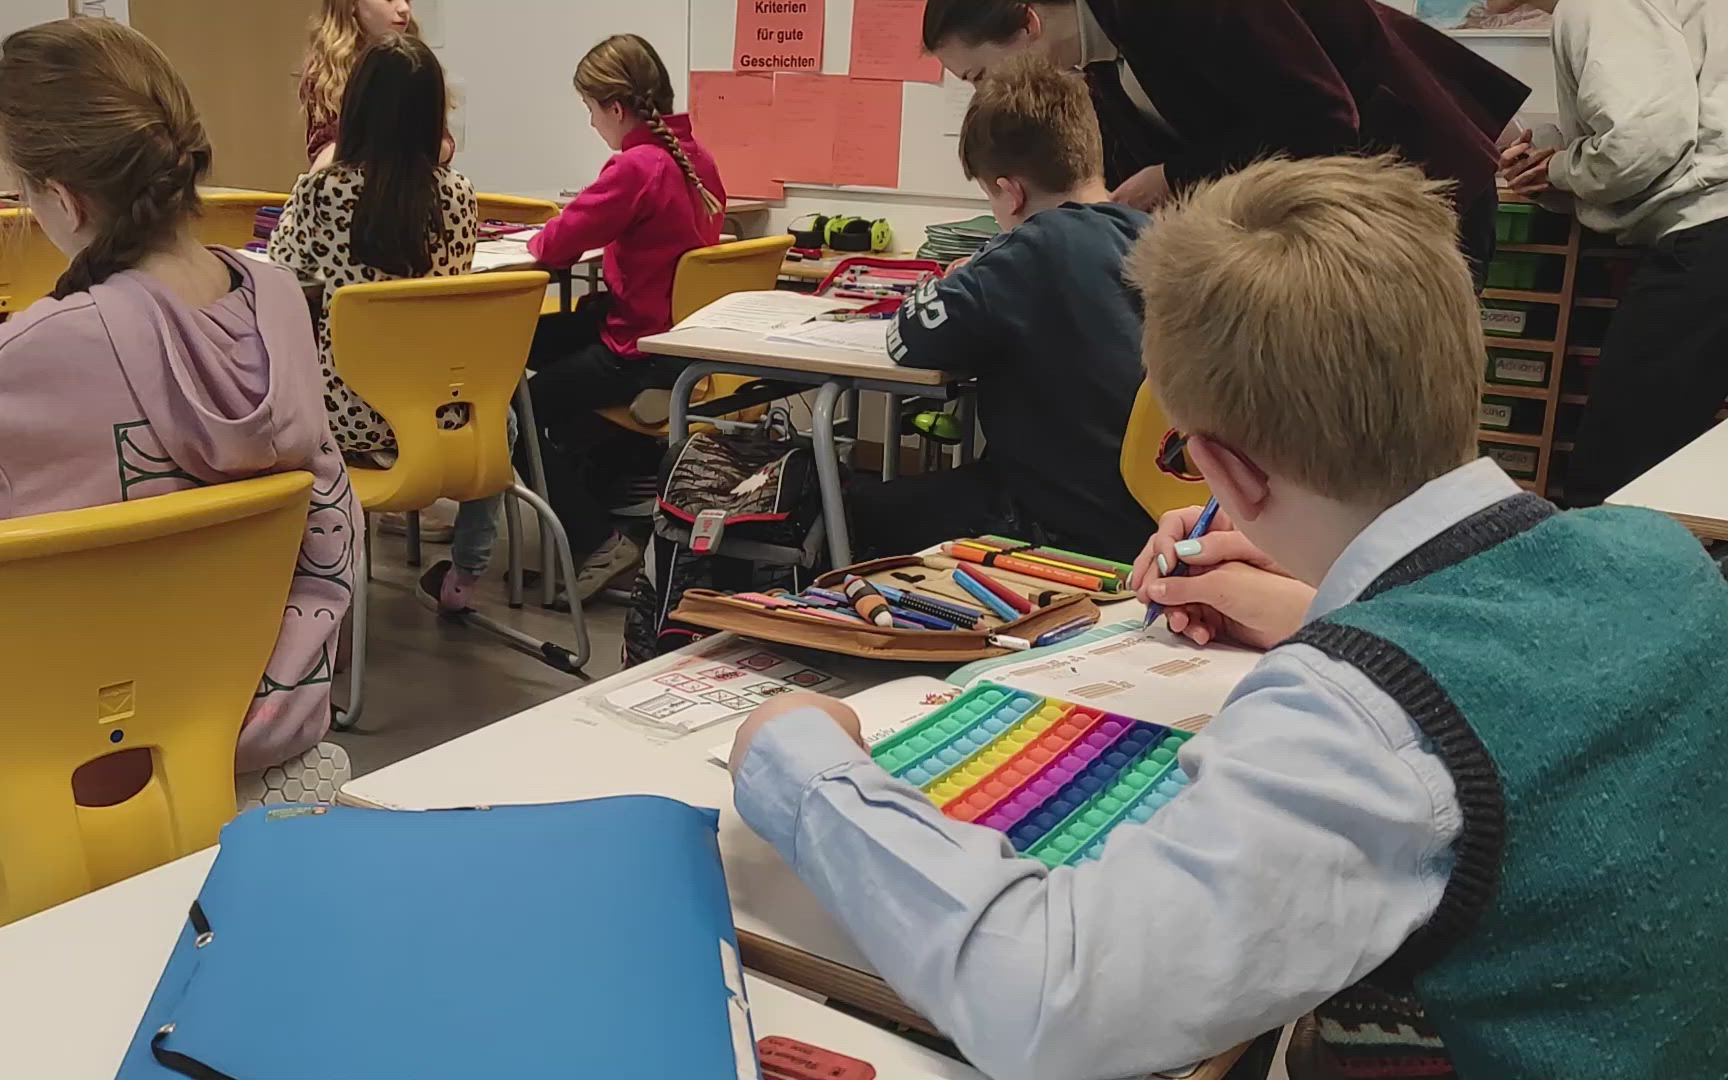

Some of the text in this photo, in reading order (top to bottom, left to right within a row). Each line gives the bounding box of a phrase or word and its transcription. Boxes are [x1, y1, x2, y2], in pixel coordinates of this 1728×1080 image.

[755, 1, 806, 13] Kriterien
[757, 28, 803, 43] für gute
[740, 55, 815, 67] Geschichten
